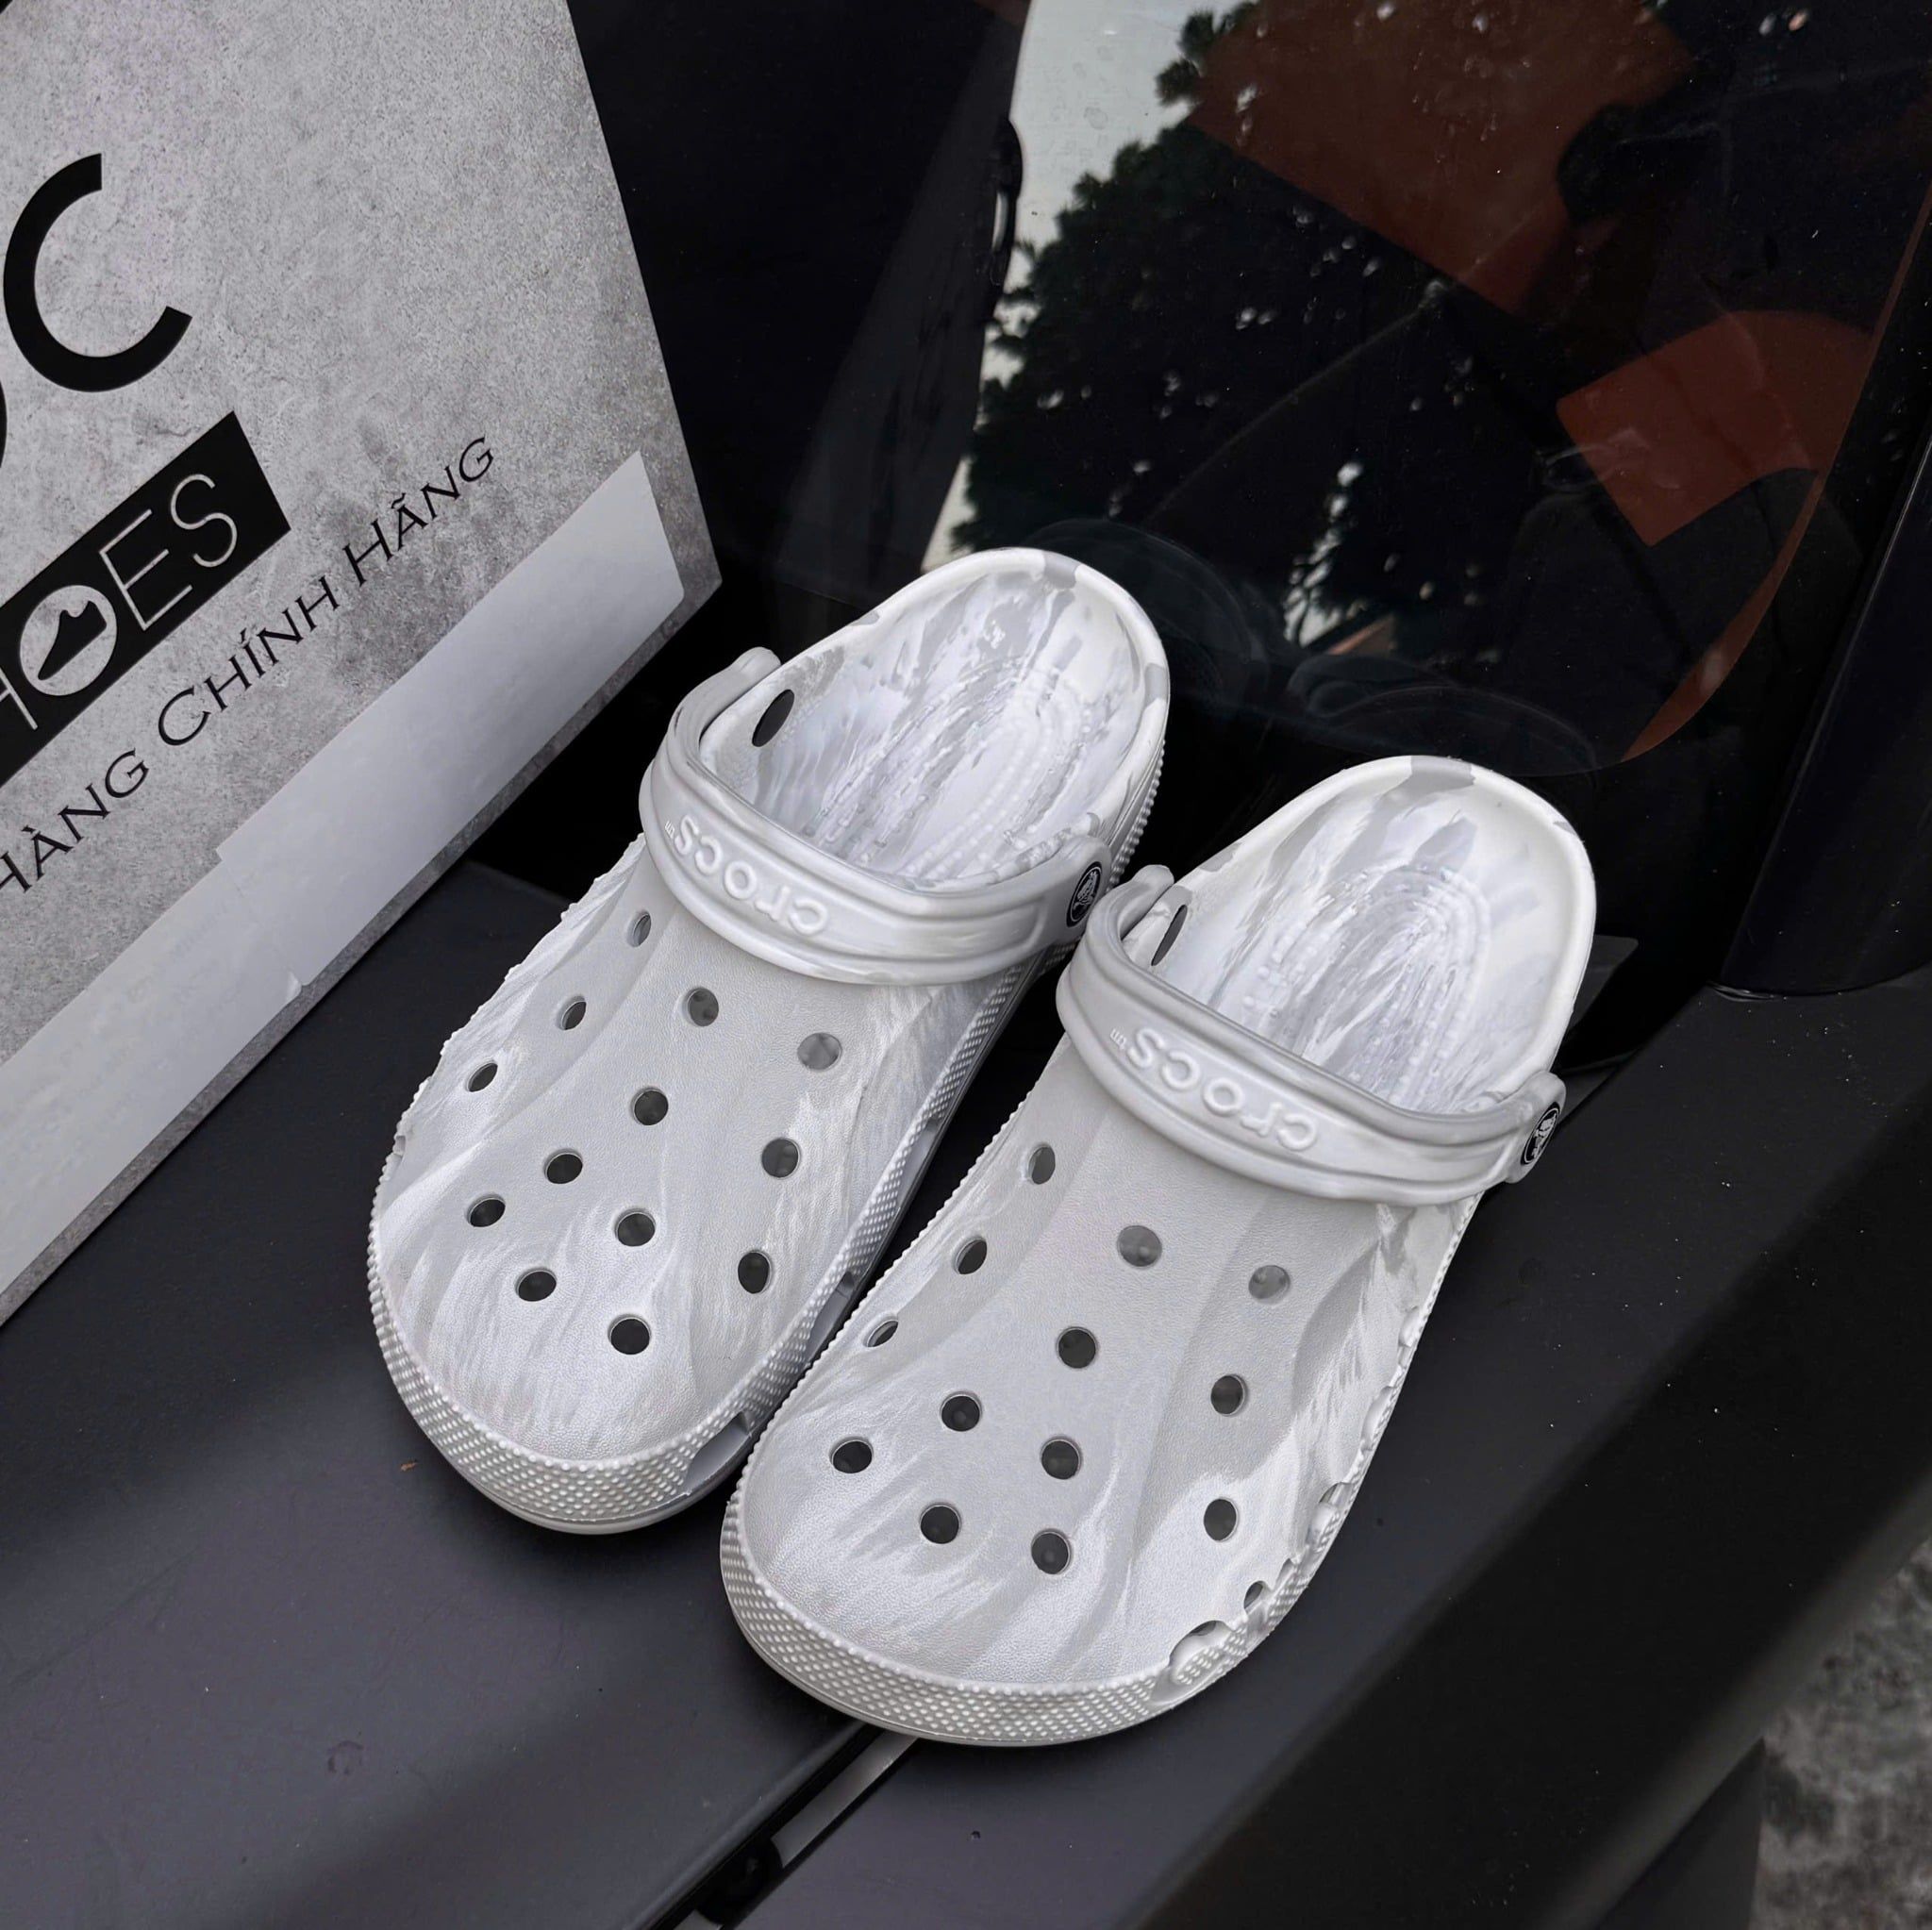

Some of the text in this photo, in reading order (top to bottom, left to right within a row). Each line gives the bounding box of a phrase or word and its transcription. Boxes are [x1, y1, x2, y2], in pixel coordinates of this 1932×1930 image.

[0, 153, 193, 466] C
[158, 575, 340, 746] CHÍNH
[342, 435, 494, 587] HÃNG
